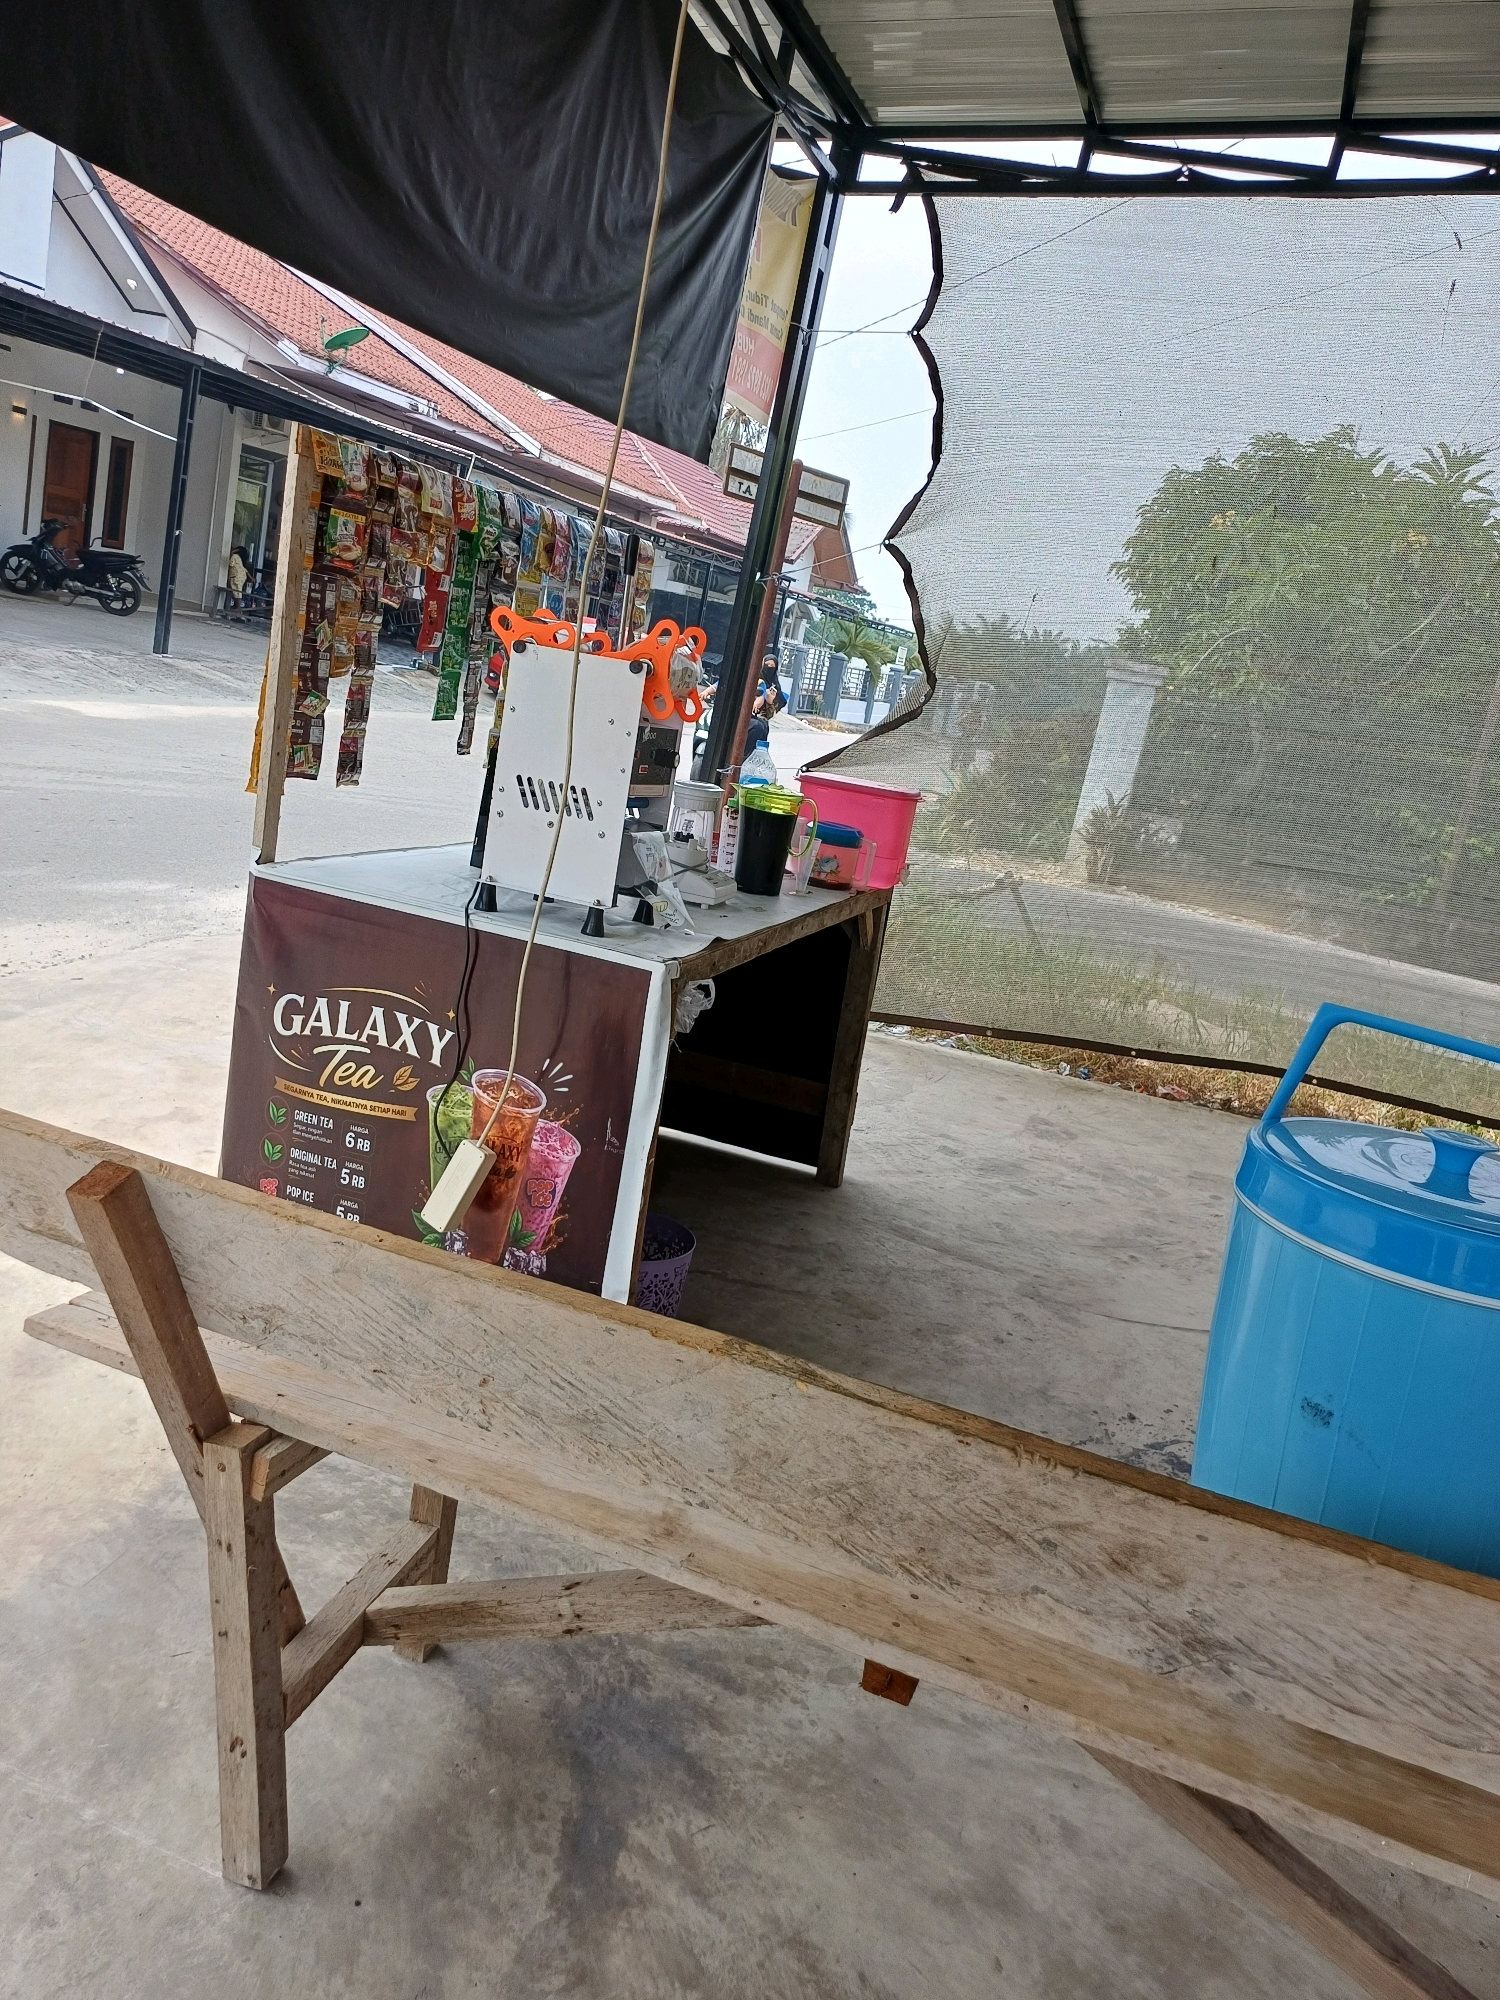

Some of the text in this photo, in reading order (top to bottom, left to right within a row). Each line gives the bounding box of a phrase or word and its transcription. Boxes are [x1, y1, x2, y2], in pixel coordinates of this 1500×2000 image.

[273, 993, 456, 1068] GALAXY
[313, 1043, 384, 1089] Tea
[283, 1083, 407, 1117] SEGARNYA TEA, NIKMATNYA SETIAP HARI
[294, 1109, 334, 1130] GREEN TEA
[350, 1124, 369, 1135] HARGA
[345, 1131, 371, 1152] 6 RB
[290, 1147, 337, 1170] ORIGINAL TEA
[345, 1161, 364, 1172] HARGA
[340, 1168, 365, 1189] 5 RB
[286, 1184, 315, 1203] POP ICE
[340, 1199, 359, 1209] HARGA
[336, 1206, 345, 1219] 5
